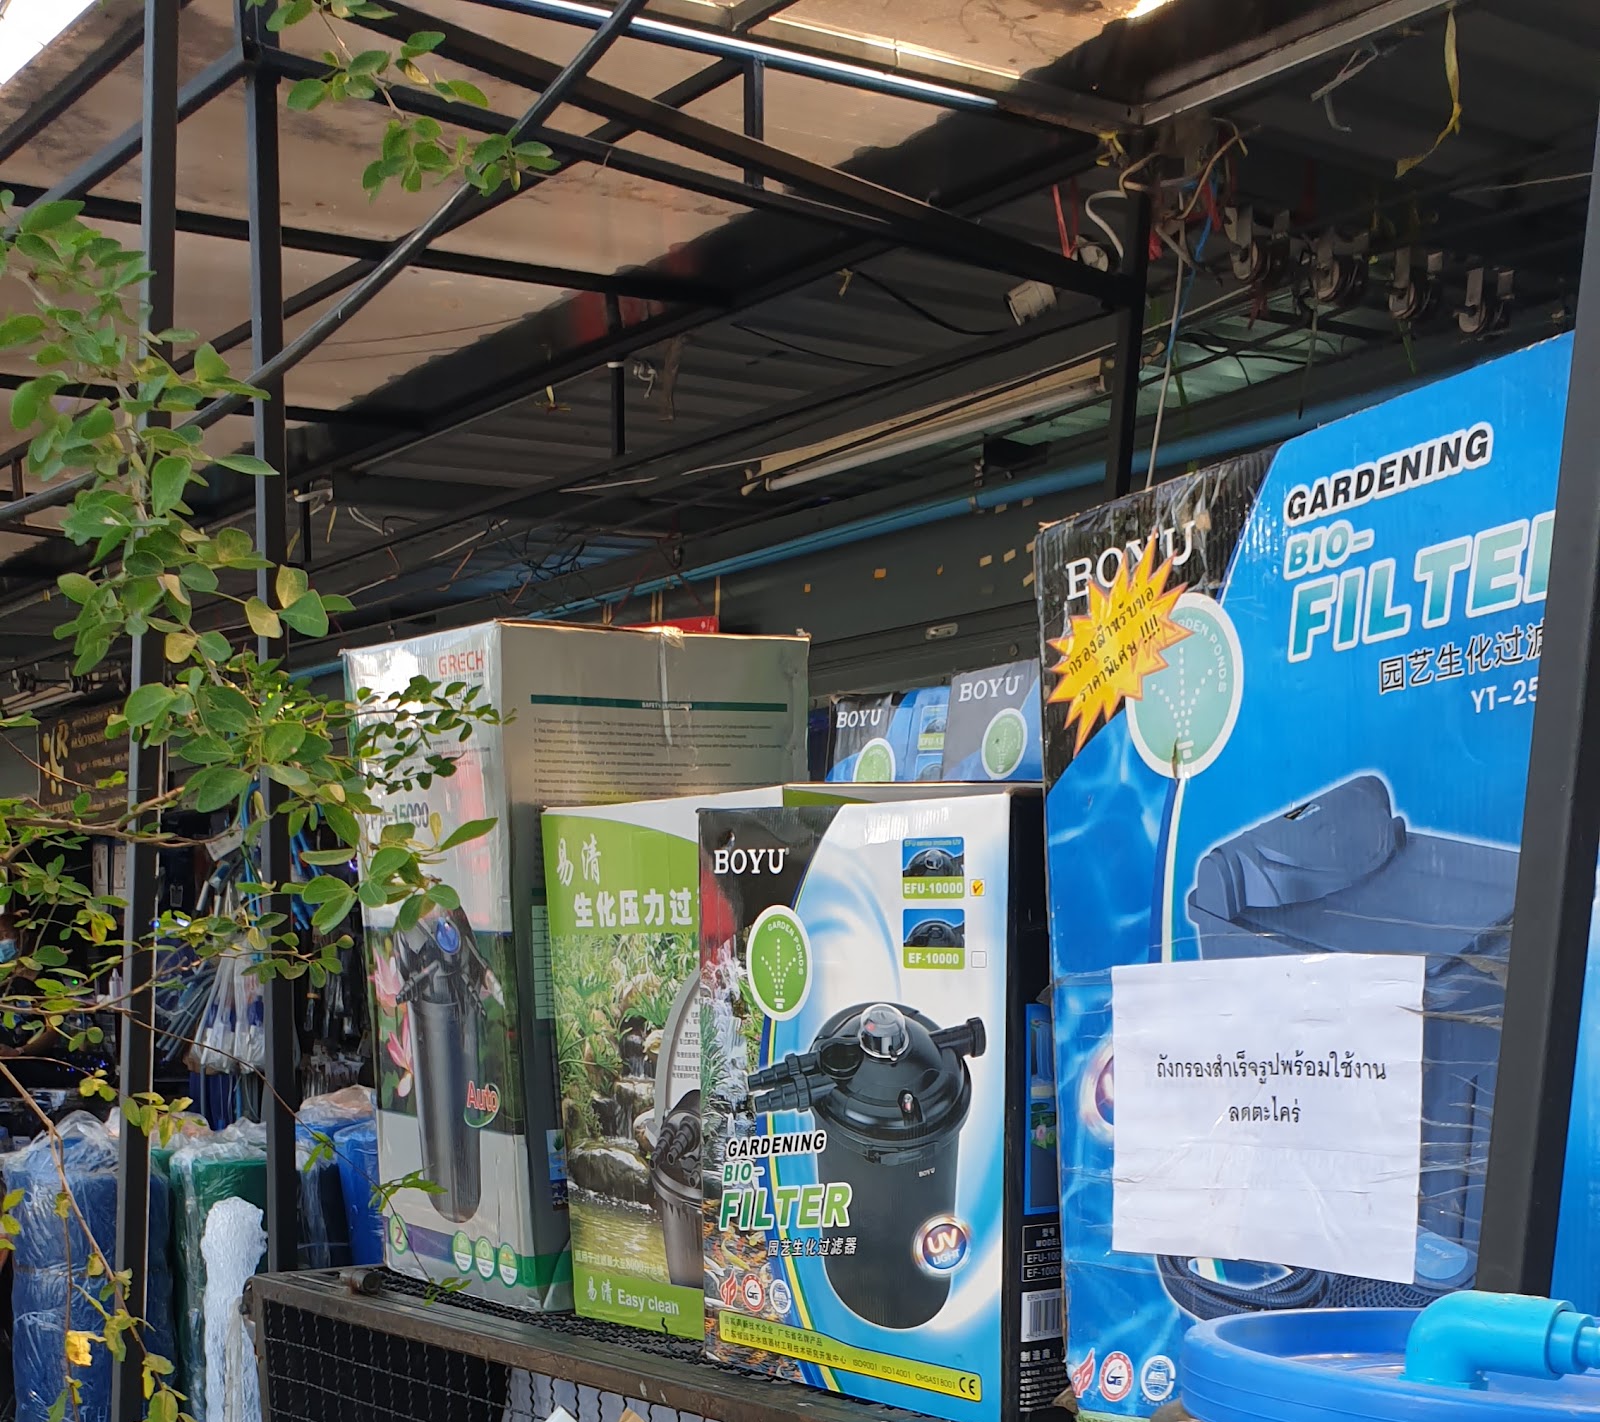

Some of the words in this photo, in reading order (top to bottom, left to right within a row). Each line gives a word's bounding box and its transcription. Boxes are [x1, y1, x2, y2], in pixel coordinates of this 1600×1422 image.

[1287, 428, 1489, 521] GARDENING
[1287, 525, 1371, 575] BIO-
[438, 649, 484, 676] GRECH
[1209, 634, 1228, 694] PONDS
[957, 675, 1021, 702] BOYU
[836, 708, 882, 729] BOYU
[713, 848, 784, 875] BOYU
[904, 882, 964, 895] EFU-10000
[573, 887, 700, 928] 生化压力过
[767, 919, 794, 937] GARDEN
[793, 936, 805, 976] PONDS
[908, 952, 960, 965] EF-10000
[1156, 1049, 1387, 1085] ถังกรองสำเร็จรูปพร้อมใช้งาน
[466, 1080, 498, 1113] Auto
[1228, 1095, 1302, 1124] ลดตะไคร่
[728, 1132, 826, 1158] GARDENING
[723, 1162, 765, 1183] BIO-
[720, 1185, 852, 1230] FILTER
[767, 1236, 858, 1257] 园艺生化过滤器
[927, 1228, 958, 1255] UV
[932, 1248, 961, 1266] LIGHT
[617, 1288, 646, 1313] Easy
[647, 1295, 680, 1316] clean
[852, 1358, 878, 1371] ISO9001
[881, 1364, 912, 1379] ISO14001
